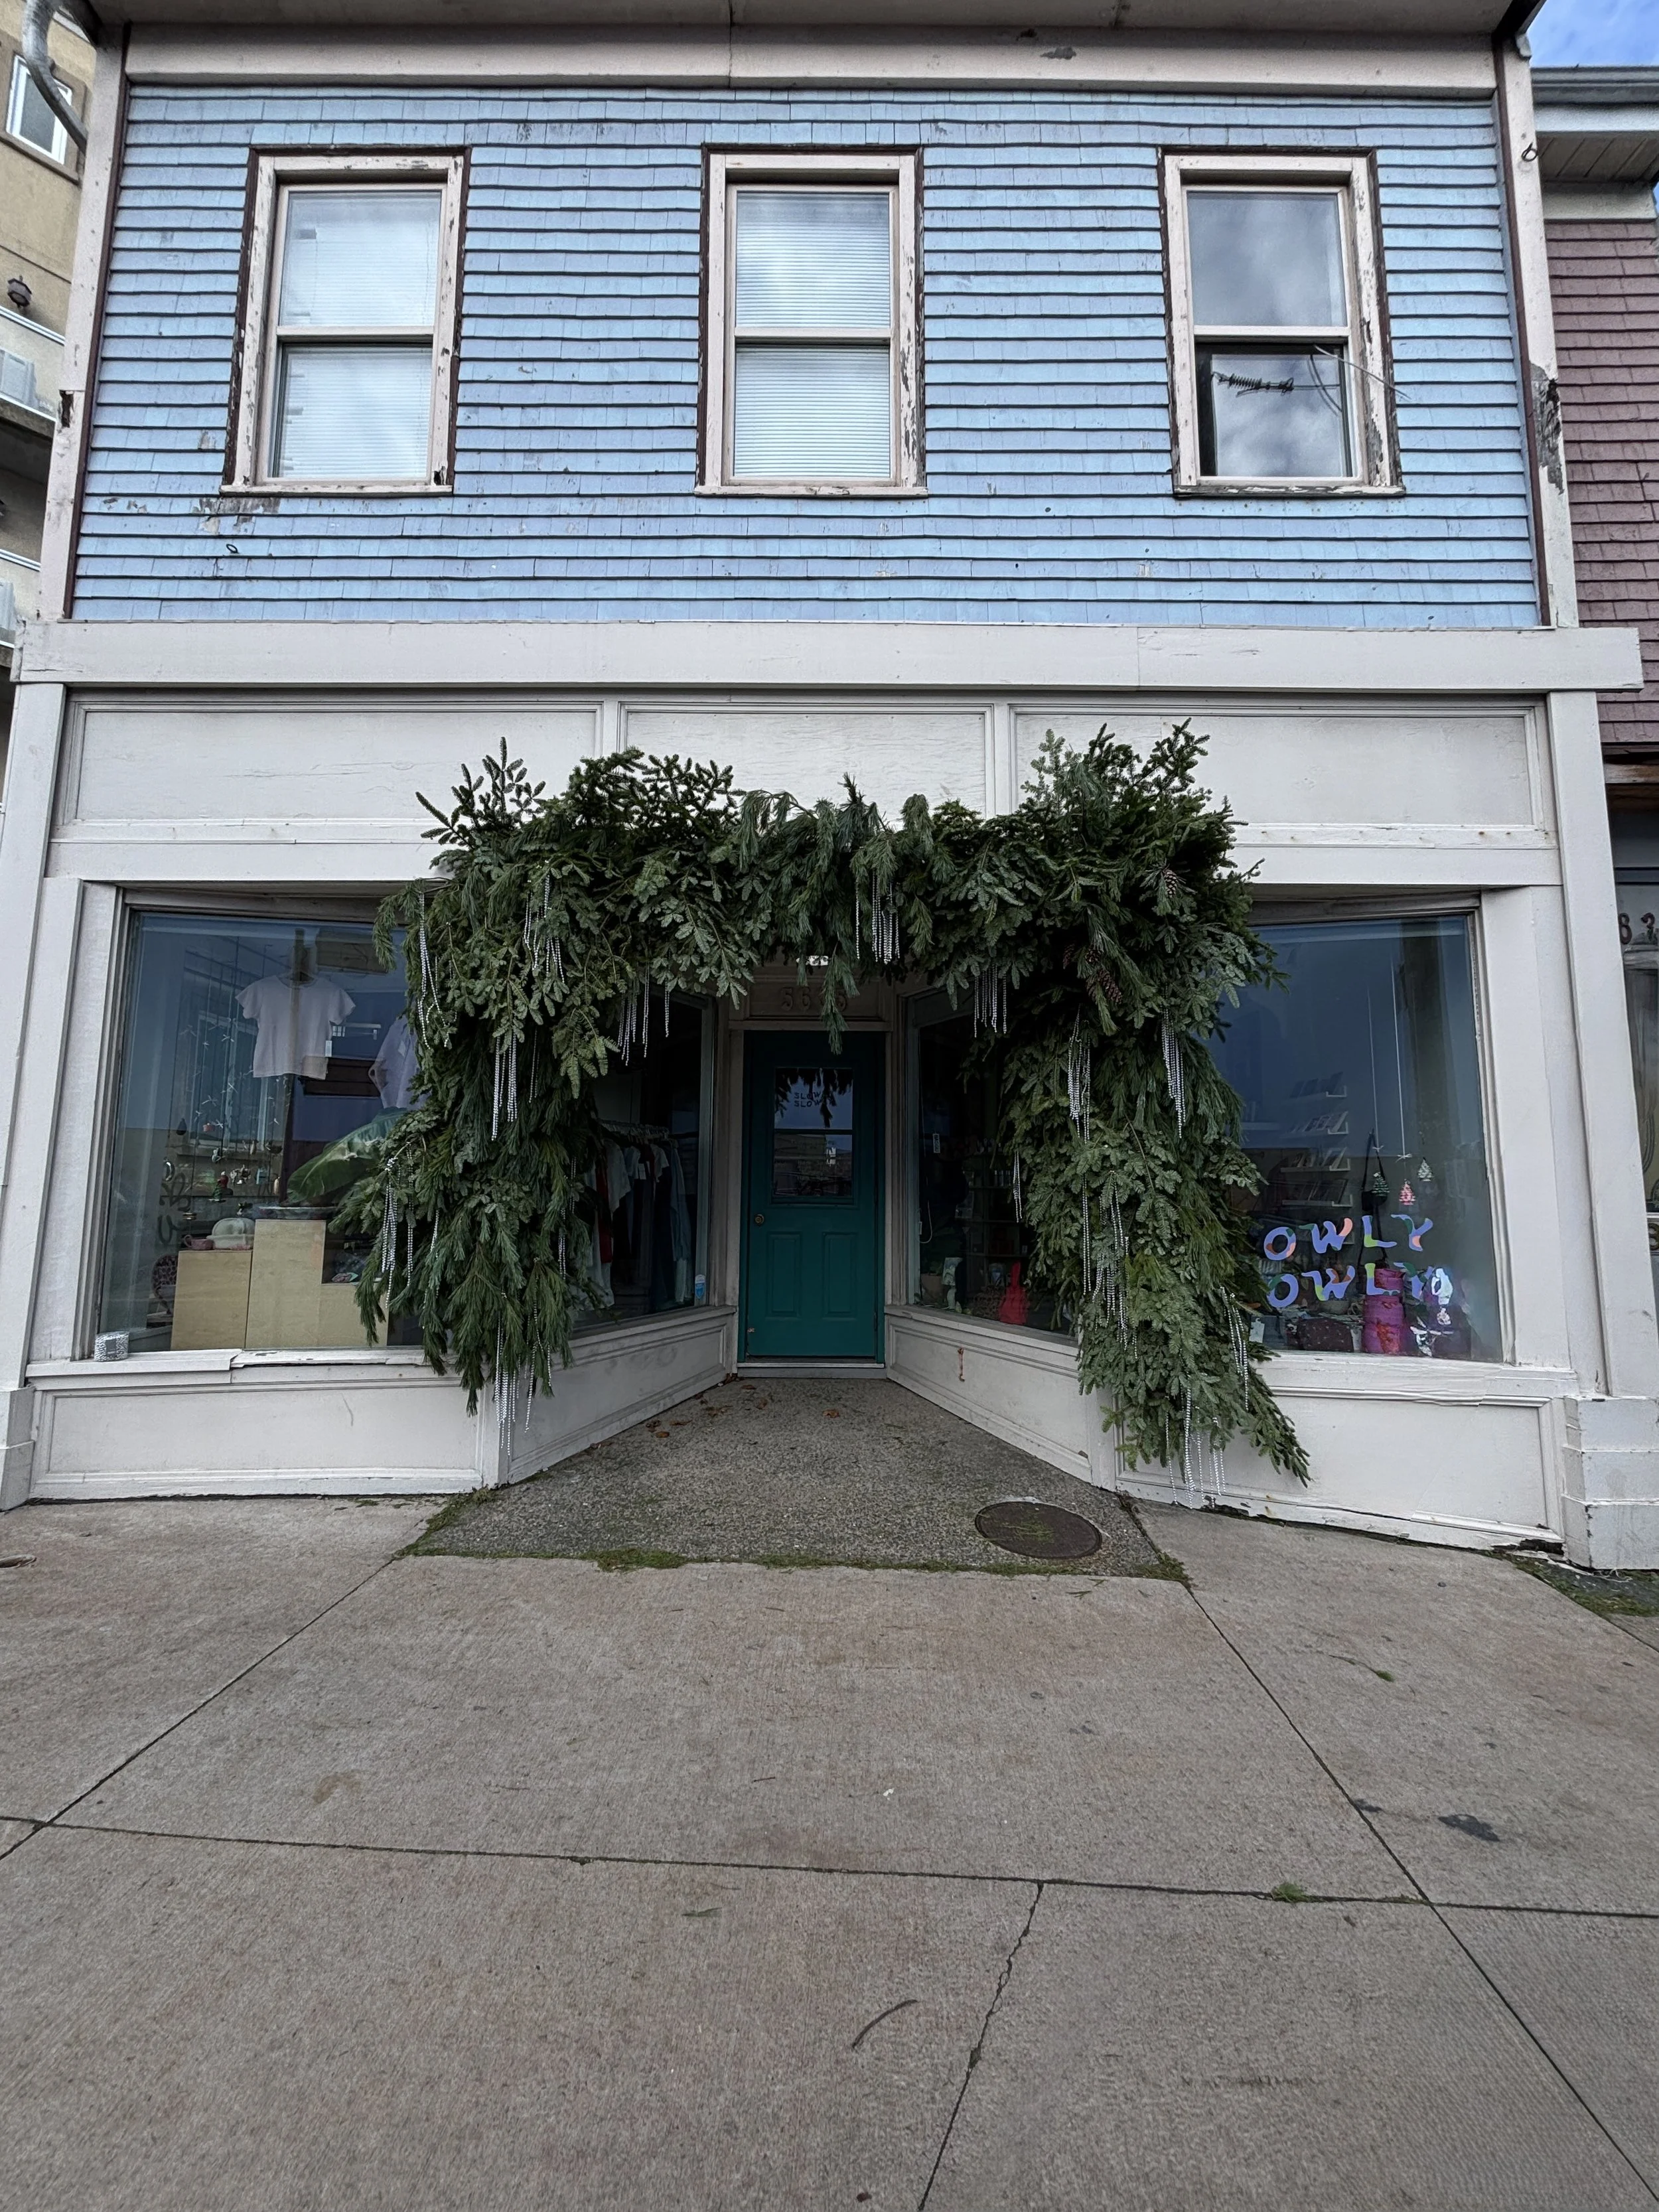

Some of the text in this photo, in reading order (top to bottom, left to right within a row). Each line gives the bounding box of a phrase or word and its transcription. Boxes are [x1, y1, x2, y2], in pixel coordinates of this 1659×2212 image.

[780, 986, 848, 1012] 565
[794, 1100, 823, 1108] SLOW
[1263, 1214, 1433, 1260] OWLY
[1267, 1262, 1435, 1307] OWLY
